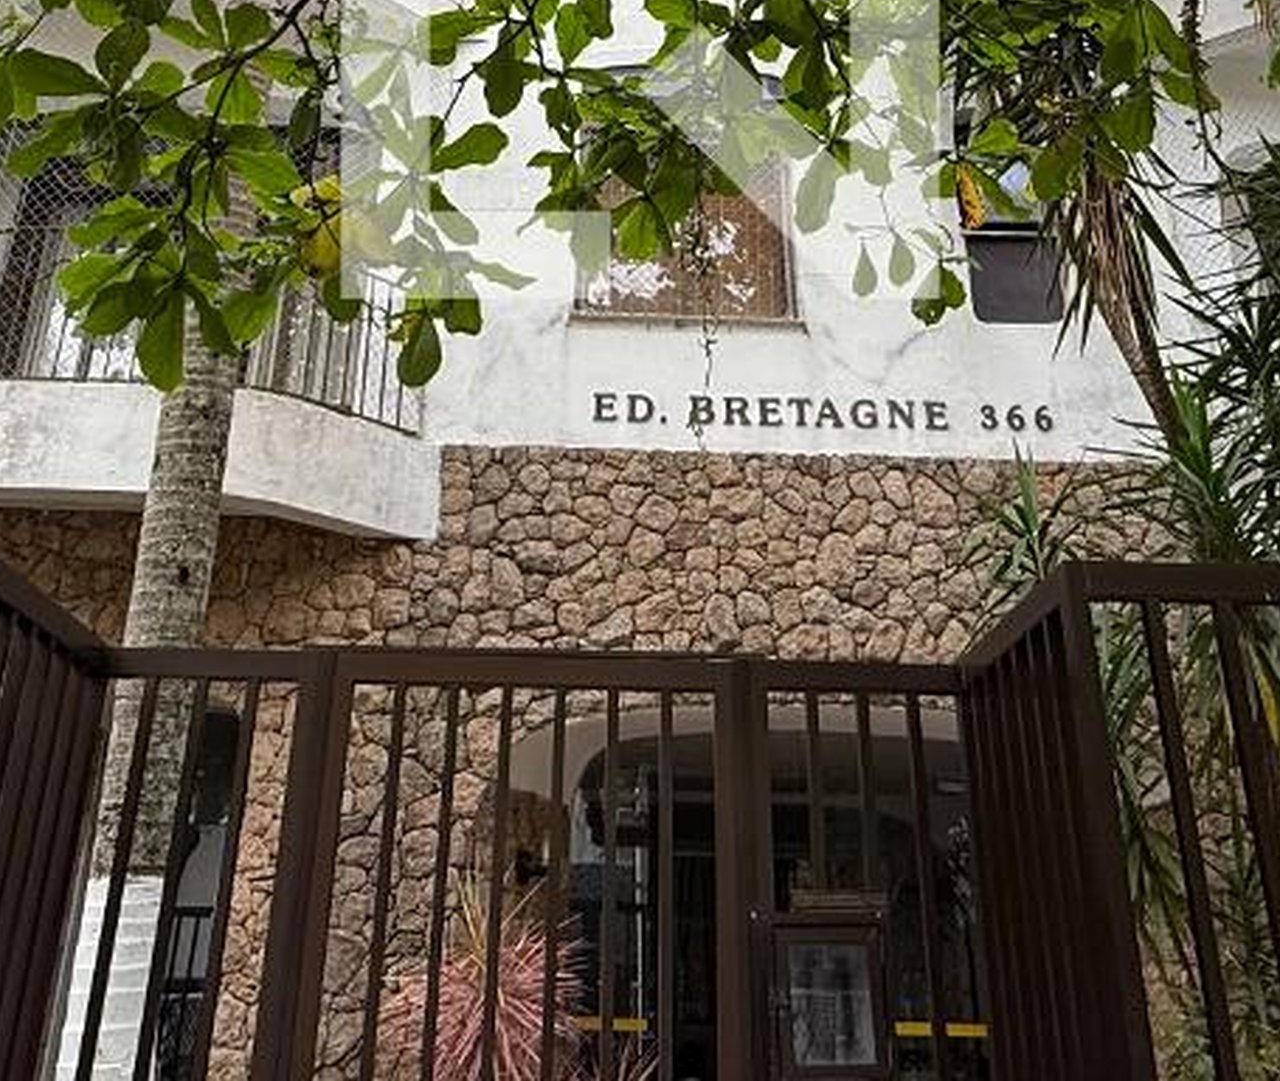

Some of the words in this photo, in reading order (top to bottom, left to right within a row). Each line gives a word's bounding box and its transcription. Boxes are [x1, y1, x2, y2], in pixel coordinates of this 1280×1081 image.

[592, 392, 668, 425] ED.
[689, 395, 949, 431] BRETAGNE
[980, 404, 1055, 433] 366
